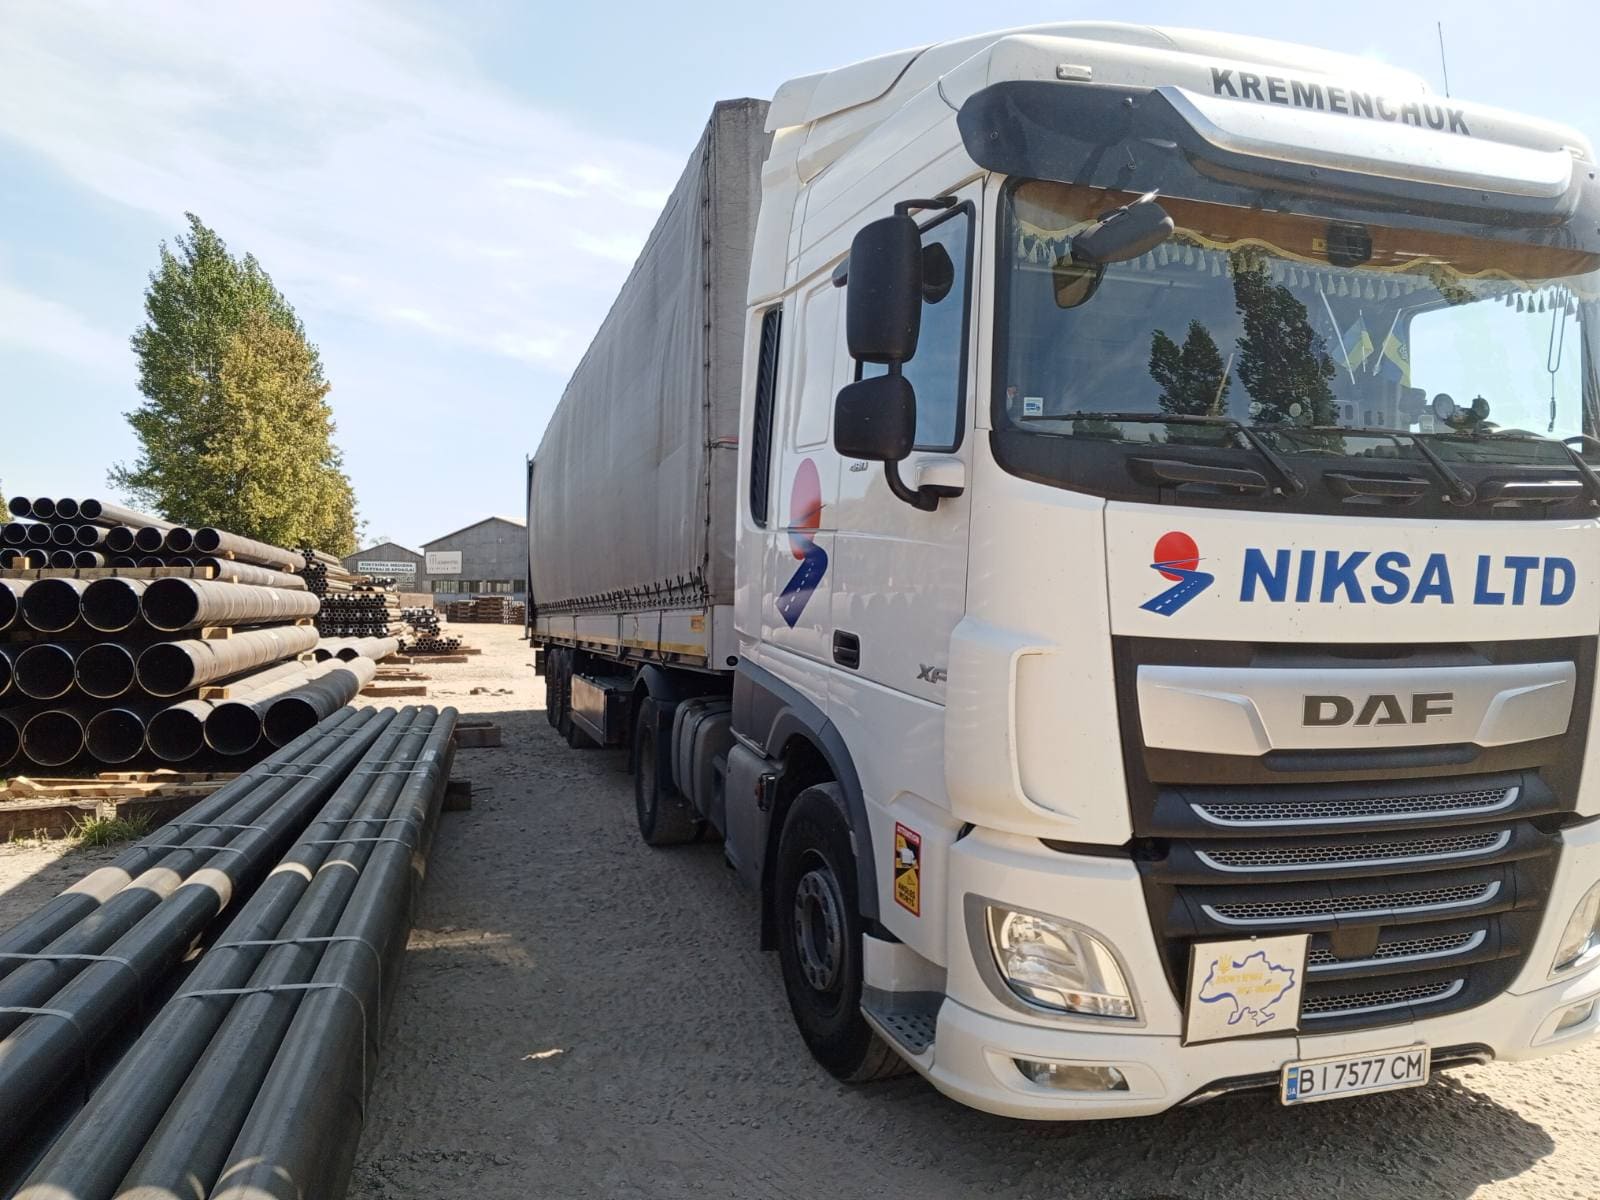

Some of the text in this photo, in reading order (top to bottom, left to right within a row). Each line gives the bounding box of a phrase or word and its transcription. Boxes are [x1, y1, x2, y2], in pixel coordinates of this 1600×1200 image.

[1210, 66, 1471, 136] KREMENCHUK
[1239, 548, 1576, 606] NIKSA LTD
[1302, 693, 1454, 727] DAF
